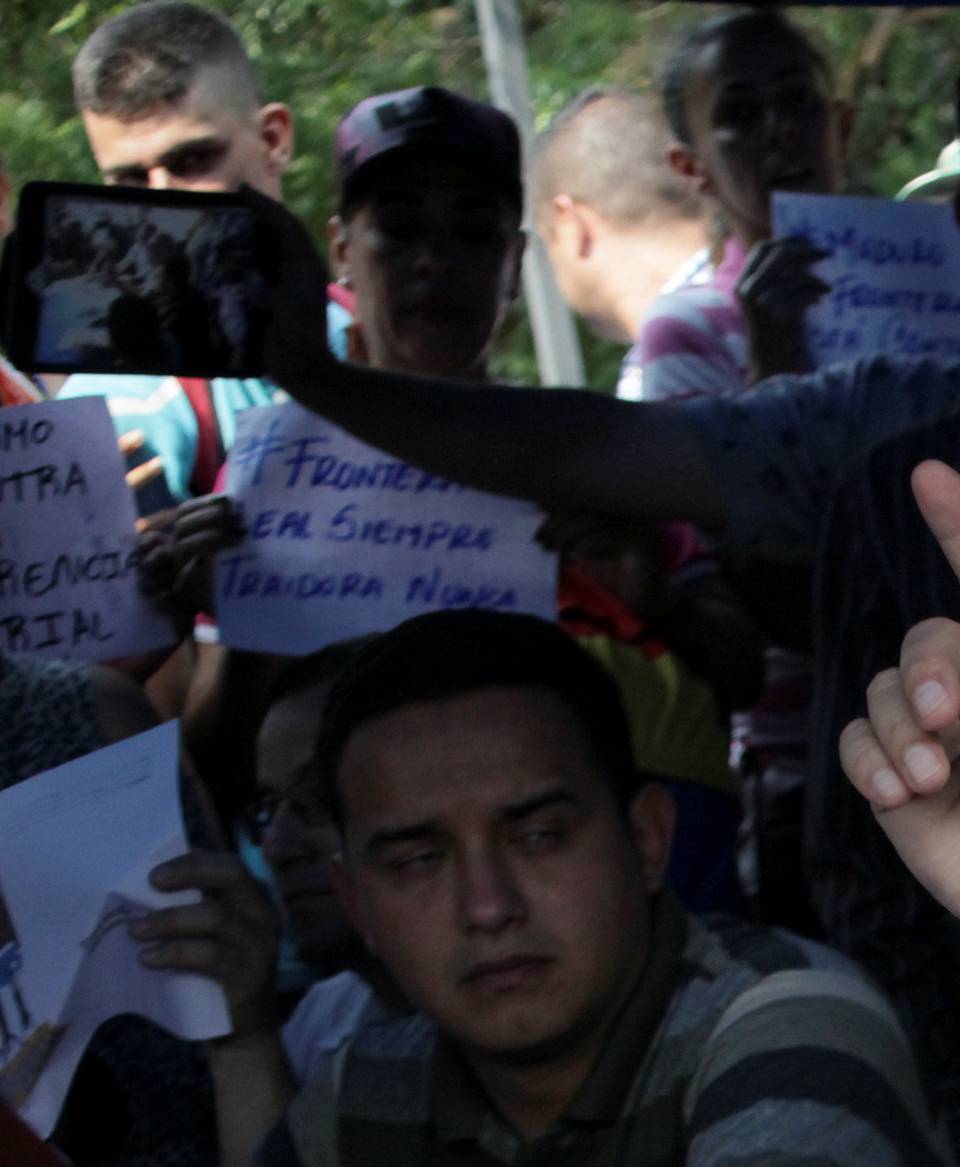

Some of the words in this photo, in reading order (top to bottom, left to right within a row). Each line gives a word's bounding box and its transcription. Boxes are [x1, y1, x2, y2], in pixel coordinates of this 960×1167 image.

[0, 462, 88, 503] TRA
[237, 503, 312, 540] EAL
[327, 503, 495, 551] SIEMPRE
[219, 552, 385, 599] TRAIDORA
